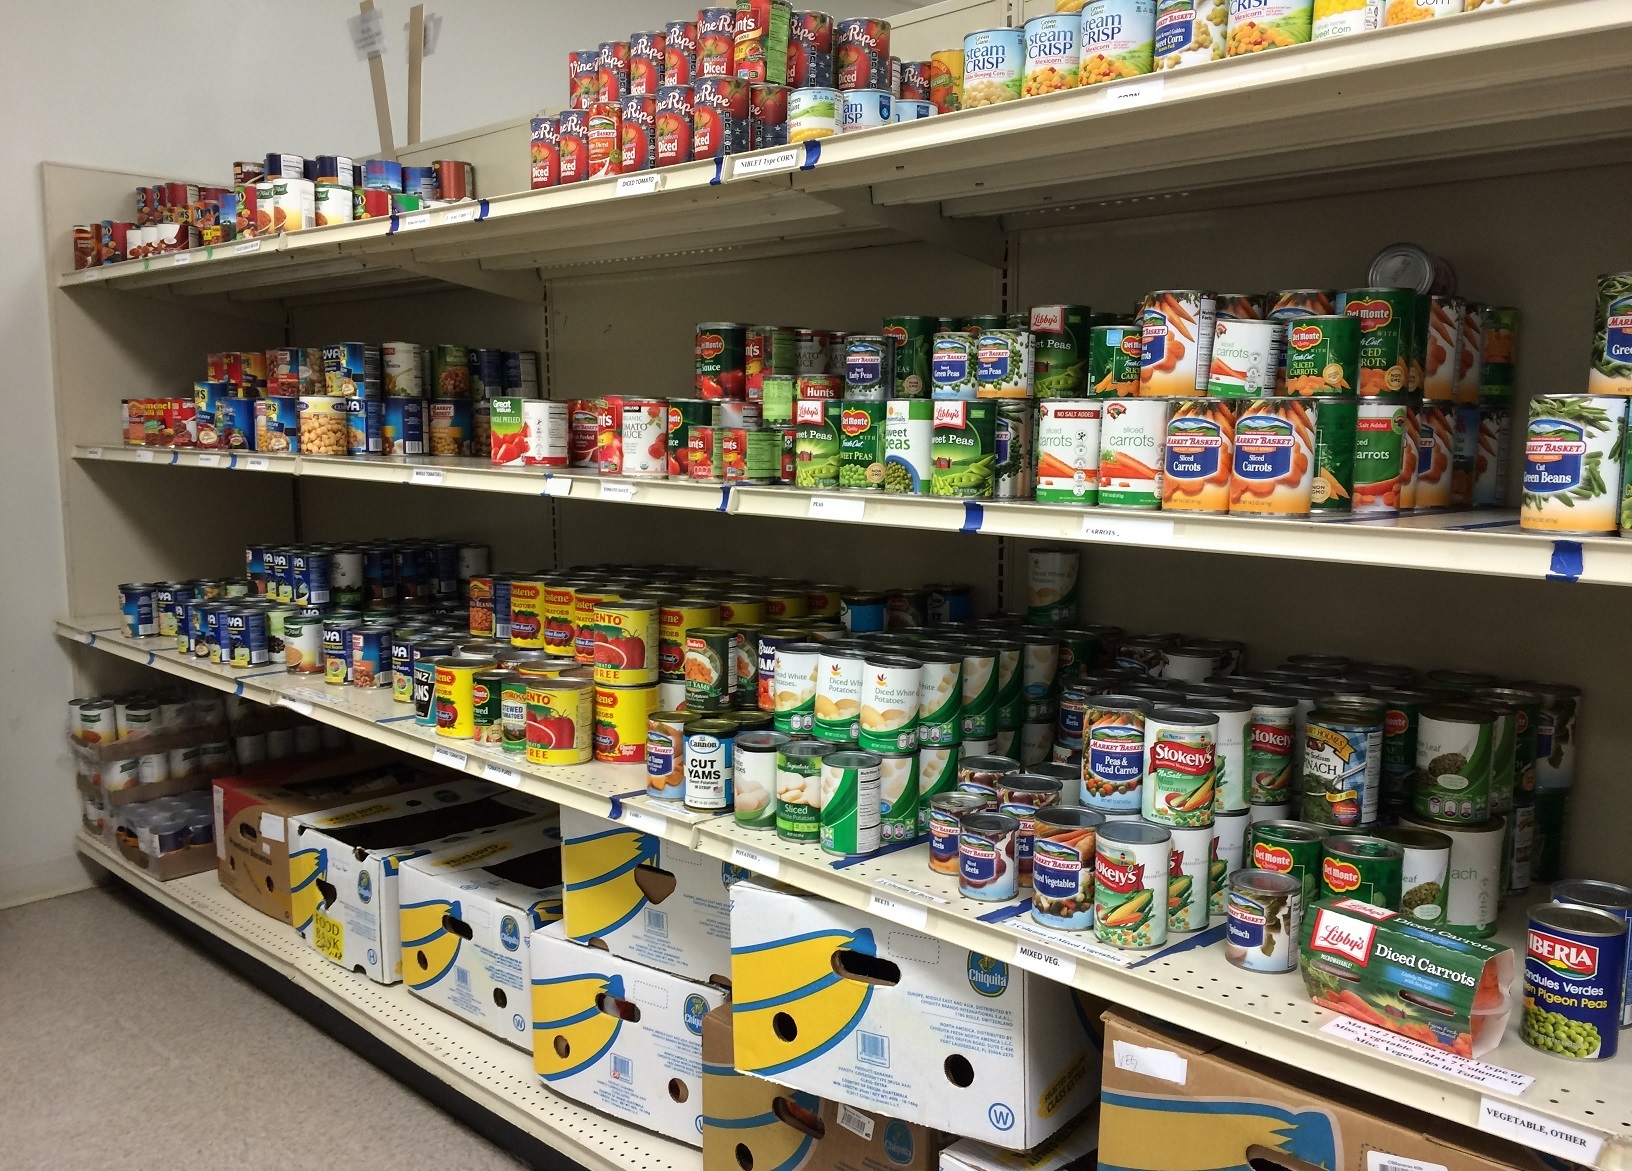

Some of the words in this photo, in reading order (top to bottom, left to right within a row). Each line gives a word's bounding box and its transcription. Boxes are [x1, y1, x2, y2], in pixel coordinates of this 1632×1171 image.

[1082, 13, 1122, 32] steam
[848, 24, 877, 47] Ripe
[1332, 25, 1351, 35] Corn
[670, 27, 697, 50] Ripe
[1029, 30, 1074, 47] steam
[1081, 26, 1123, 48] CRISP
[1168, 34, 1184, 44] Corn
[638, 38, 665, 60] Ripe
[965, 45, 1006, 62] steam
[1028, 42, 1074, 59] CRISP
[601, 48, 625, 68] Ripe
[703, 63, 727, 74] Diced
[966, 56, 1006, 74] CRISP
[904, 67, 930, 89] Ripe
[702, 85, 730, 107] Ripe
[669, 92, 695, 116] Ripe
[628, 101, 654, 124] Ripe
[658, 140, 678, 153] Diced
[740, 158, 763, 168] NIBLET
[763, 157, 776, 167] Type
[776, 153, 795, 163] CORN
[532, 165, 549, 177] Diced
[1359, 309, 1390, 320] Monte
[1291, 333, 1300, 342] Del
[1300, 331, 1320, 341] Monte
[1046, 339, 1072, 350] Peas
[1216, 347, 1249, 359] carrots
[701, 363, 721, 372] Sauce
[1289, 366, 1319, 376] CARROTS
[1292, 361, 1315, 369] SLICED
[492, 399, 512, 409] Great
[501, 416, 521, 424] PEELED
[849, 417, 868, 426] Monte
[1358, 421, 1369, 429] Salt
[1369, 421, 1388, 429] Added
[809, 430, 833, 441] Peas
[1122, 426, 1144, 434] sliced
[948, 434, 975, 447] Peas
[1109, 435, 1155, 448] carrots
[1167, 436, 1189, 447] MARKET
[1235, 436, 1259, 445] MARKET
[854, 451, 873, 461] PEAS
[1179, 454, 1194, 462] Sliced
[1248, 454, 1265, 462] Sliced
[1173, 461, 1202, 473] Carrots
[1242, 462, 1273, 473] Carrots
[1536, 463, 1546, 471] Cut
[1541, 471, 1572, 484] Beans
[787, 673, 808, 681] White
[829, 677, 849, 686] Diced
[875, 687, 896, 696] Diced
[896, 688, 916, 698] White
[874, 696, 905, 705] Potatoes
[502, 704, 524, 713] STEWED
[1317, 728, 1345, 748] HOLMES
[689, 740, 718, 749] Cannon
[1091, 741, 1119, 751] MARKET
[1104, 755, 1121, 766] Peas
[1121, 756, 1128, 766] &
[1155, 744, 1212, 768] Stokely's
[1310, 752, 1331, 762] Sodium
[690, 758, 717, 769] CUT
[1095, 763, 1114, 774] Diced
[1114, 765, 1139, 775] Carrots
[688, 768, 721, 780] YAMS
[1168, 771, 1182, 779] Salt
[784, 804, 808, 815] Sliced
[791, 813, 816, 822] Potatoes
[932, 840, 945, 850] Beets
[1255, 849, 1266, 860] Del
[1266, 853, 1291, 866] Monte
[965, 864, 980, 875] Beets
[1324, 864, 1335, 876] Del
[1334, 869, 1359, 883] Monte
[1044, 875, 1076, 889] Vegetables
[874, 896, 890, 907] BEETS
[315, 913, 340, 936] FOOD
[1240, 913, 1265, 924] BASKET
[1228, 924, 1250, 940] Spinach
[1319, 924, 1365, 952] Libby's
[1392, 917, 1438, 933] Diced
[1438, 931, 1497, 952] Carrots
[1058, 938, 1081, 949] Mixed
[1082, 946, 1122, 963] Vegetables
[1529, 933, 1593, 969] IBERIA
[1019, 947, 1043, 961] MIXED
[1044, 954, 1061, 967] VEG.
[1375, 943, 1416, 968] Diced
[1417, 958, 1476, 988] Carrots
[968, 968, 1008, 988] Chiquita
[1563, 981, 1604, 996] Verdes
[1538, 987, 1578, 1008] Pigeon
[1581, 998, 1608, 1009] Peas
[1333, 1023, 1359, 1035] Misc.
[1363, 1032, 1414, 1052] Vegetable.
[1422, 1051, 1446, 1062] Max
[1459, 1062, 1508, 1082] Columns
[1345, 1020, 1367, 1030] Max
[1391, 1034, 1437, 1052] Columns
[1452, 1055, 1473, 1063] any
[1484, 1064, 1509, 1076] type
[1353, 1036, 1380, 1049] Misc.
[1385, 1046, 1439, 1069] Vegetables
[1456, 1069, 1486, 1082] Total
[994, 1109, 1009, 1126] W
[1486, 1107, 1548, 1136] VEGETABLE,
[1550, 1129, 1587, 1148] OTHER
